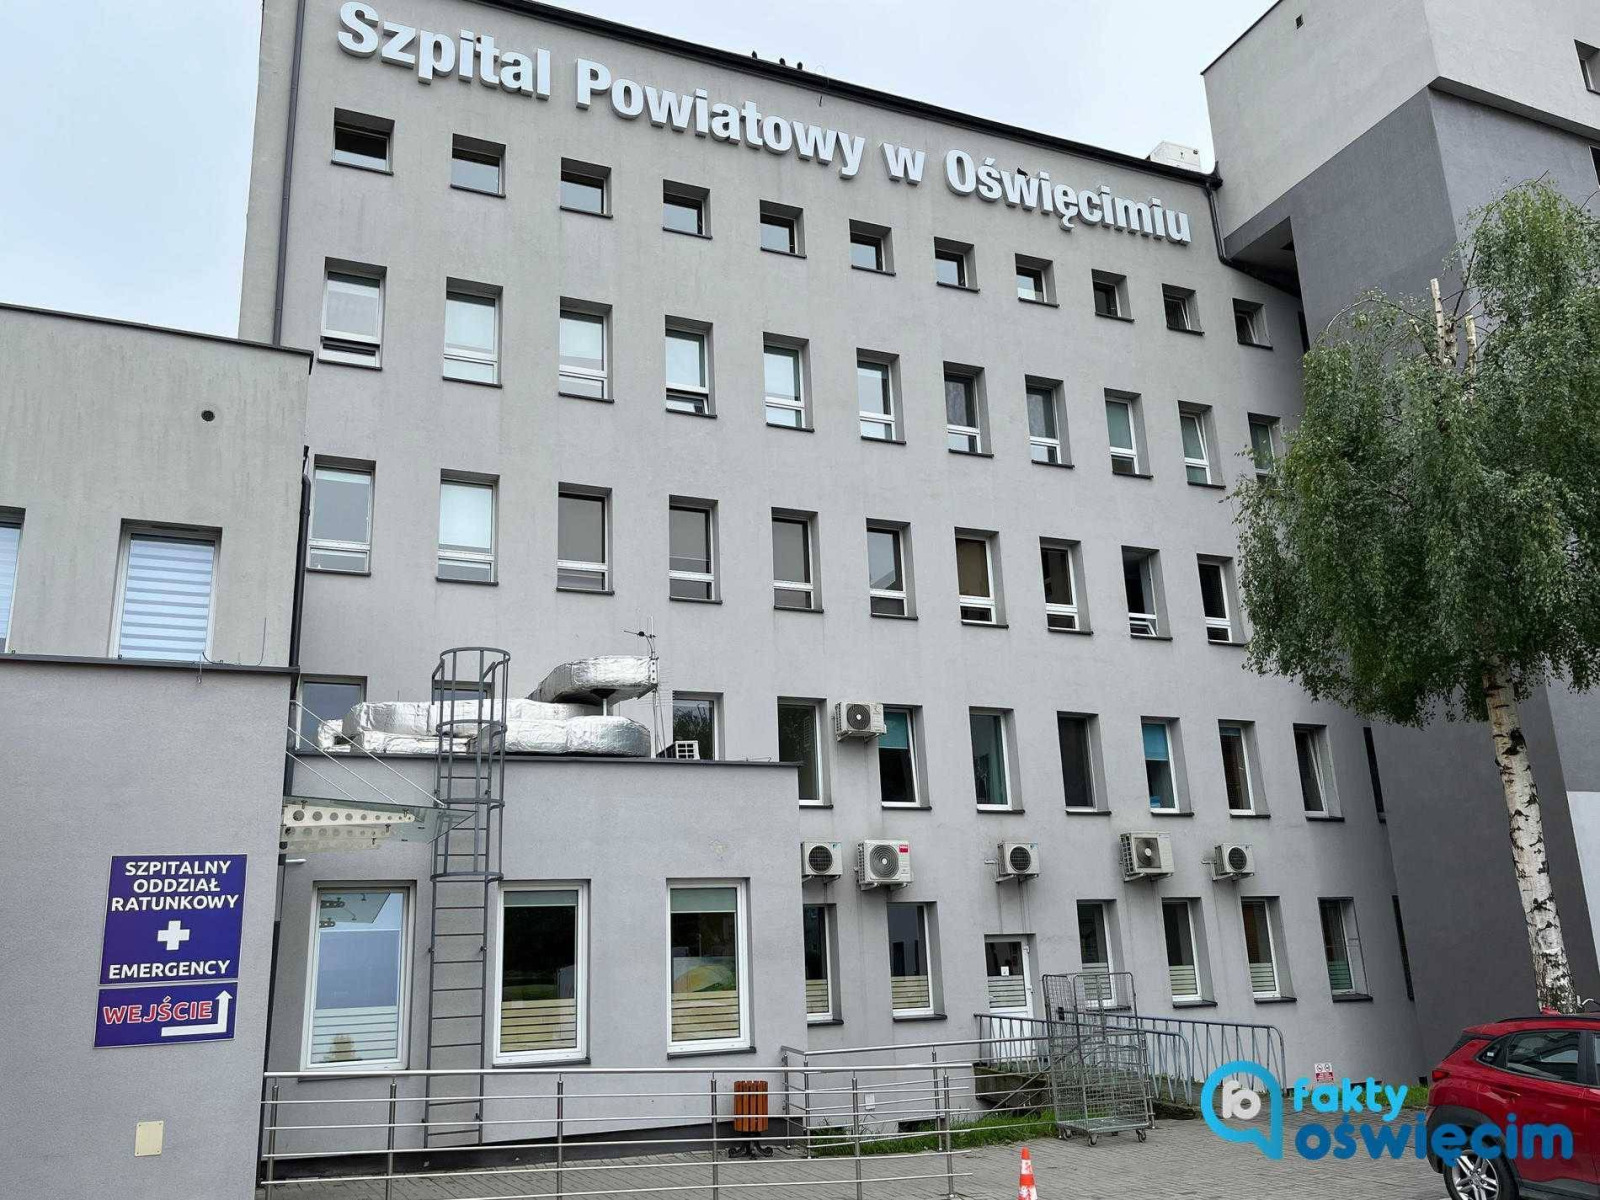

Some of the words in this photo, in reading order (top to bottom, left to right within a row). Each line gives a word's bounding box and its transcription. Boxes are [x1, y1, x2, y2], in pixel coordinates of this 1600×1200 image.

[337, 1, 551, 100] Szpital
[575, 57, 866, 180] Powiatowy
[881, 142, 926, 185] w
[943, 148, 1192, 246] Oświęcimiu
[125, 860, 231, 876] SZPITALNY
[133, 877, 221, 893] ODDZIAŁ
[111, 894, 239, 912] RATUNKOWY
[108, 960, 231, 979] EMERGENCY
[102, 995, 213, 1025] WEJŚCIE
